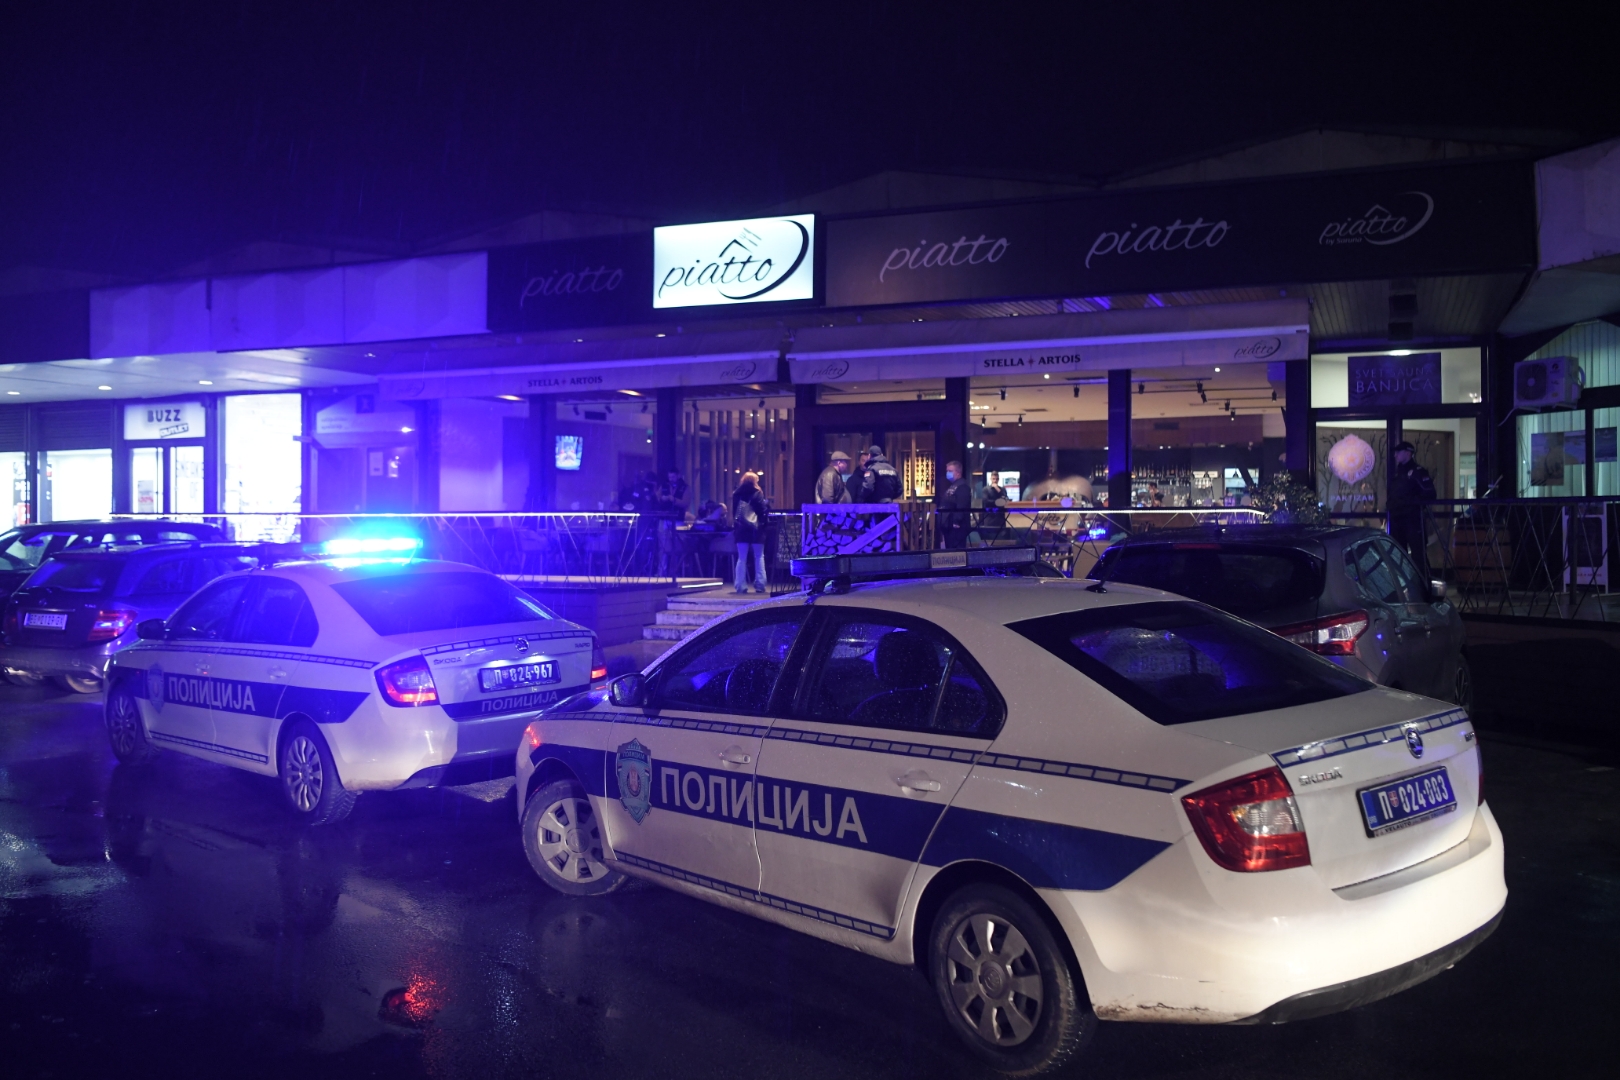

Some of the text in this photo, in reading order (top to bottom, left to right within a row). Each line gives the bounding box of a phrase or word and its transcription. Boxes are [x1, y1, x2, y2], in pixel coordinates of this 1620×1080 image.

[1084, 217, 1232, 269] piatto
[1318, 215, 1407, 245] piatto
[879, 234, 1011, 283] piatto
[520, 265, 625, 308] piatto
[658, 255, 776, 298] piatto
[984, 355, 1081, 368] STELLA ARTOIS
[527, 376, 603, 387] STELLA ARTOIS
[1356, 378, 1433, 393] BANJICA
[147, 409, 181, 422] BUZZ
[168, 676, 256, 711] ПОЛИЦИЈА
[481, 690, 558, 712] ПОЛИЦИЈА
[660, 766, 868, 844] ПОЛИЦИЈА
